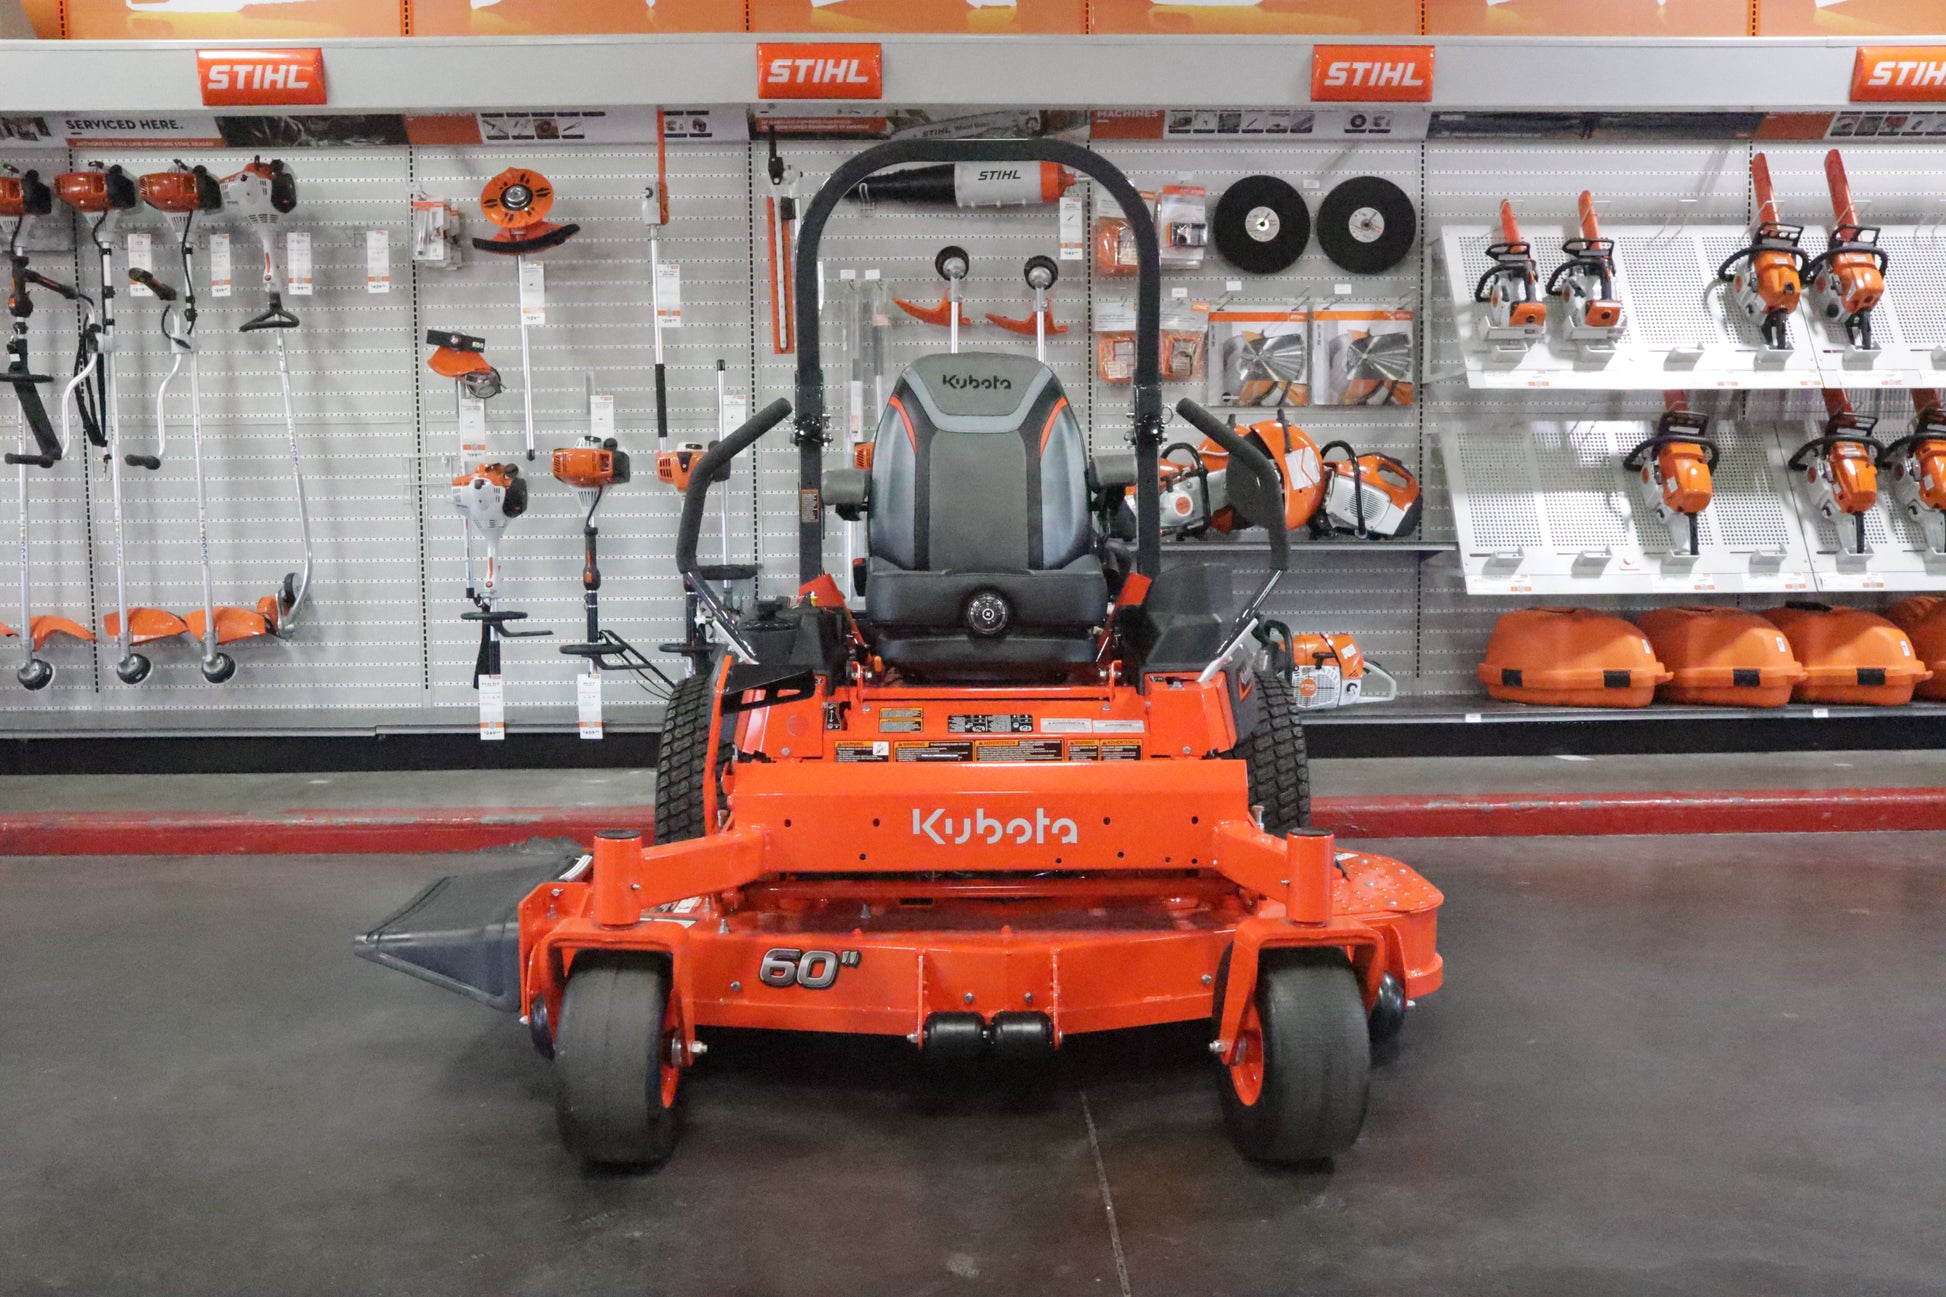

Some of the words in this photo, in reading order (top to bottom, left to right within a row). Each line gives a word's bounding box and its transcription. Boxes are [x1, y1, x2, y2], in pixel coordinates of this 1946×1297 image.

[207, 64, 309, 91] STIHL
[767, 58, 869, 84] STIHL
[1324, 61, 1424, 88] STIHL
[1867, 61, 1946, 87] STIH
[65, 119, 136, 130] SERVICED
[140, 119, 184, 130] HERE.
[977, 169, 1021, 181] STIHL
[942, 374, 1012, 390] Kubota
[912, 808, 1078, 844] Kubota
[759, 947, 862, 990] 60"
